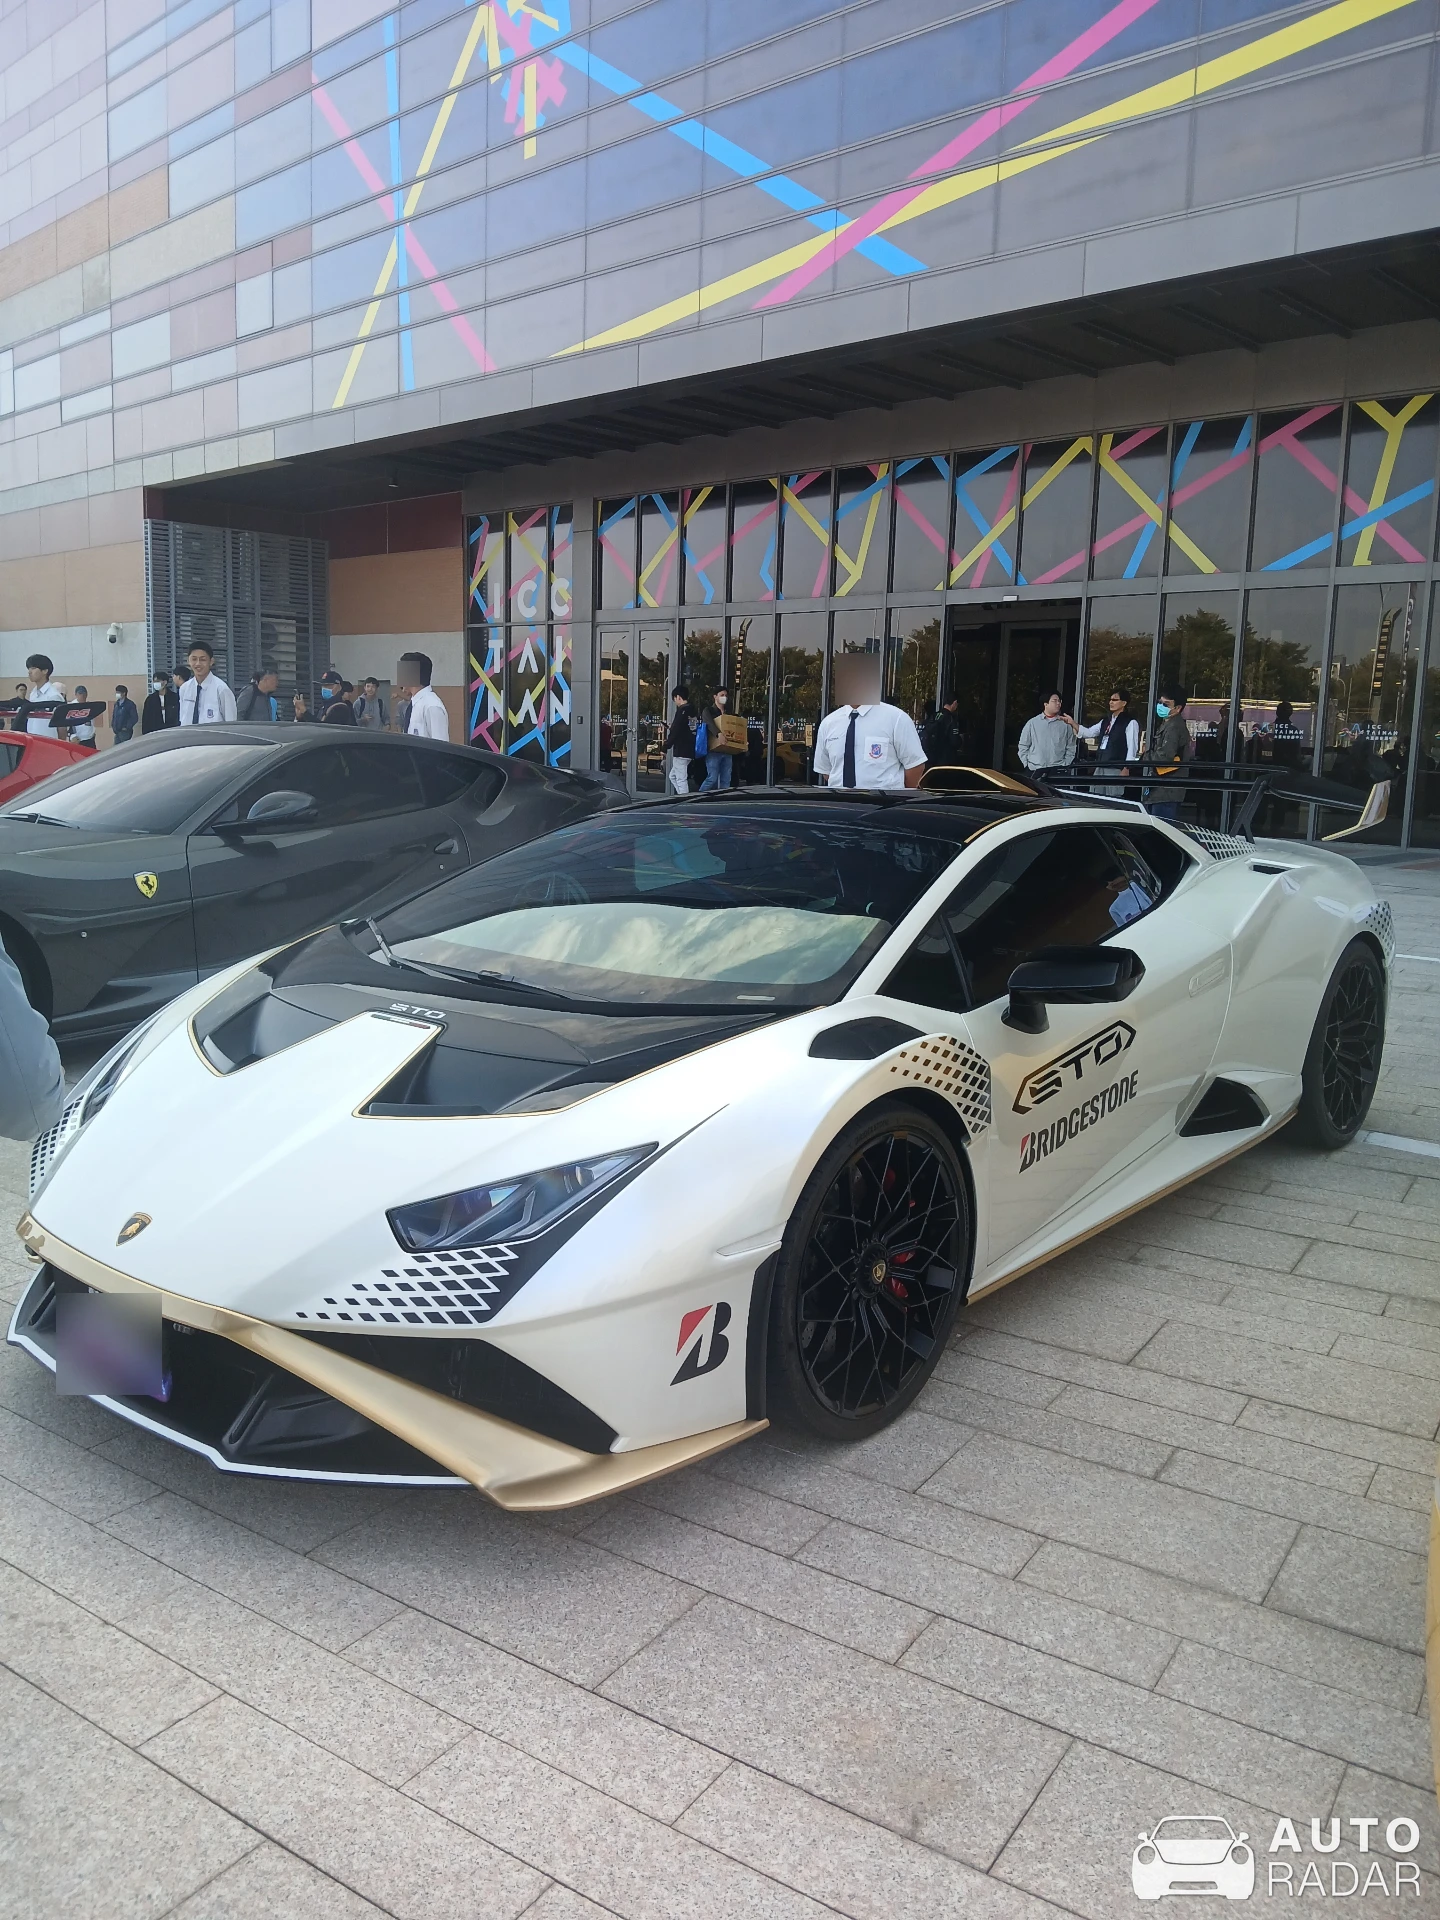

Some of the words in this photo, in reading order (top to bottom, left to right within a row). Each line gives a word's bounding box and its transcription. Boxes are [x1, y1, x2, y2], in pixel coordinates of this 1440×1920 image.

[493, 578, 570, 619] ICC
[488, 636, 563, 674] TAI
[66, 708, 91, 719] RS
[487, 689, 570, 726] NAN
[389, 1002, 447, 1019] STO
[1029, 1030, 1123, 1105] STO
[1018, 1068, 1139, 1174] BRIDGESTONE
